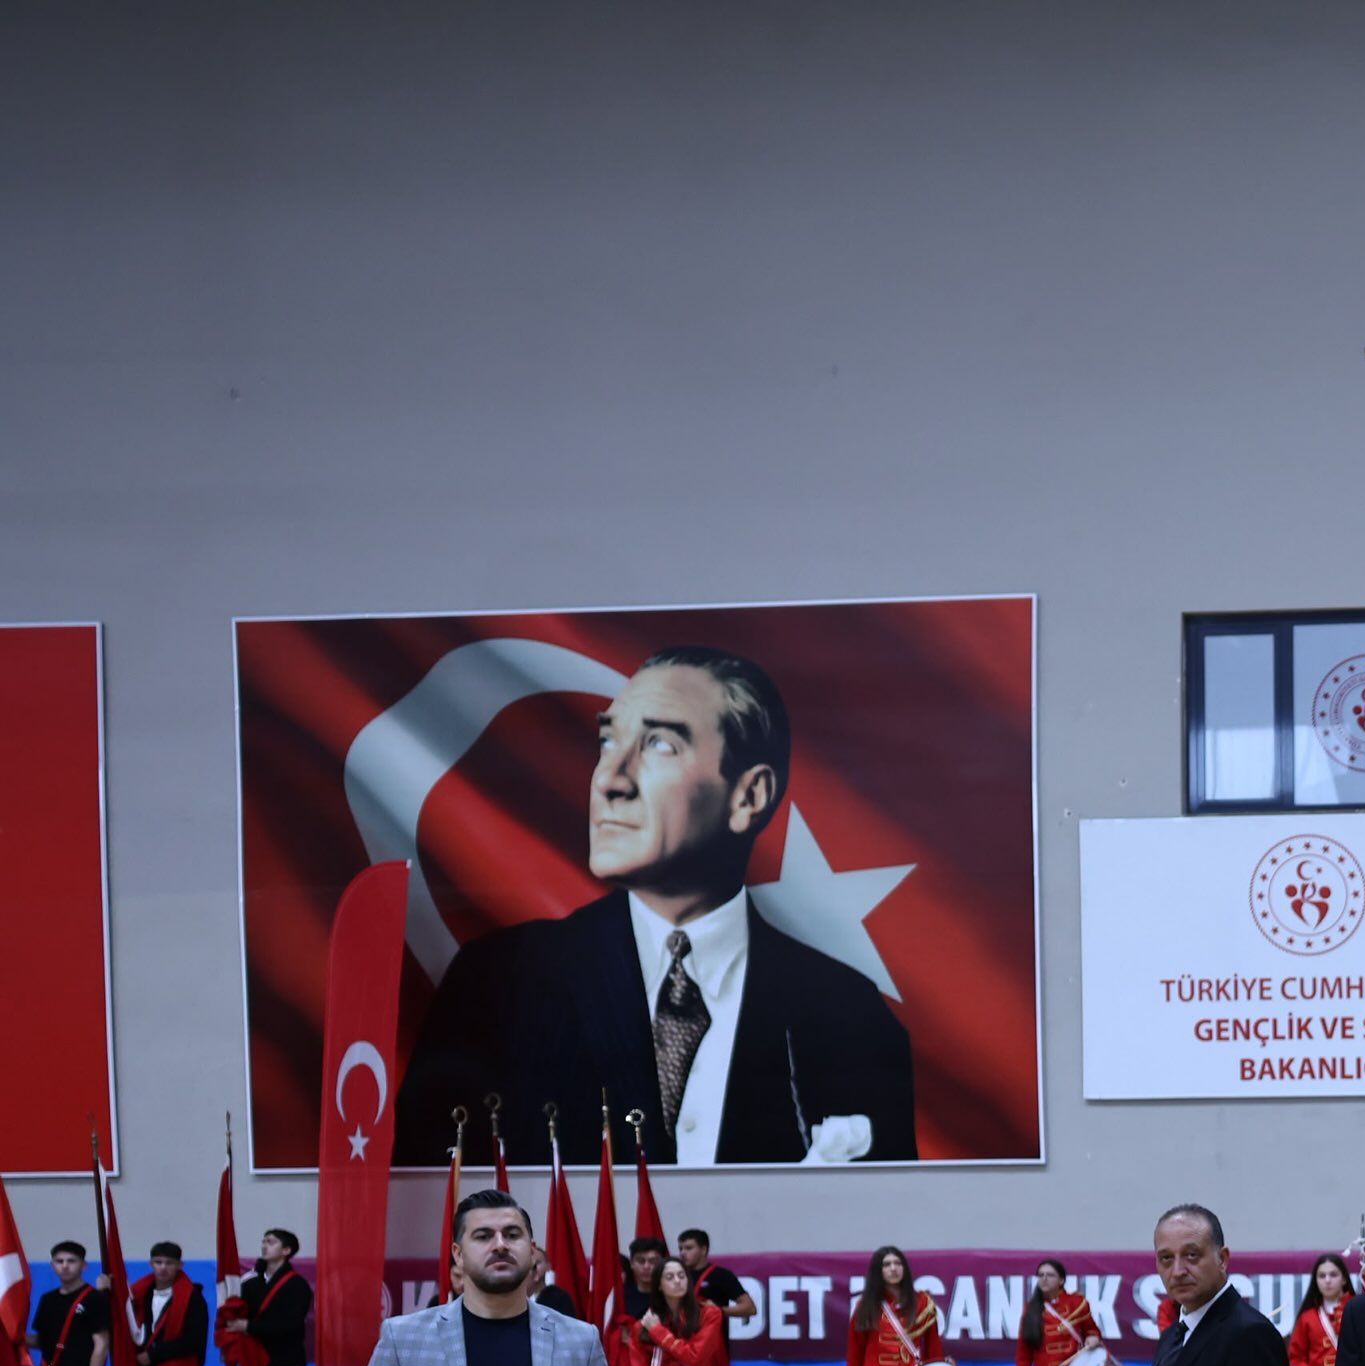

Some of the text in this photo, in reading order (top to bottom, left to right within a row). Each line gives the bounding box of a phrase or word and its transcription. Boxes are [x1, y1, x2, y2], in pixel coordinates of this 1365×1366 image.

[1160, 973, 1273, 1002] TÜRKİYE
[1193, 1012, 1314, 1047] GENÇLİK
[1320, 1016, 1355, 1039] VE
